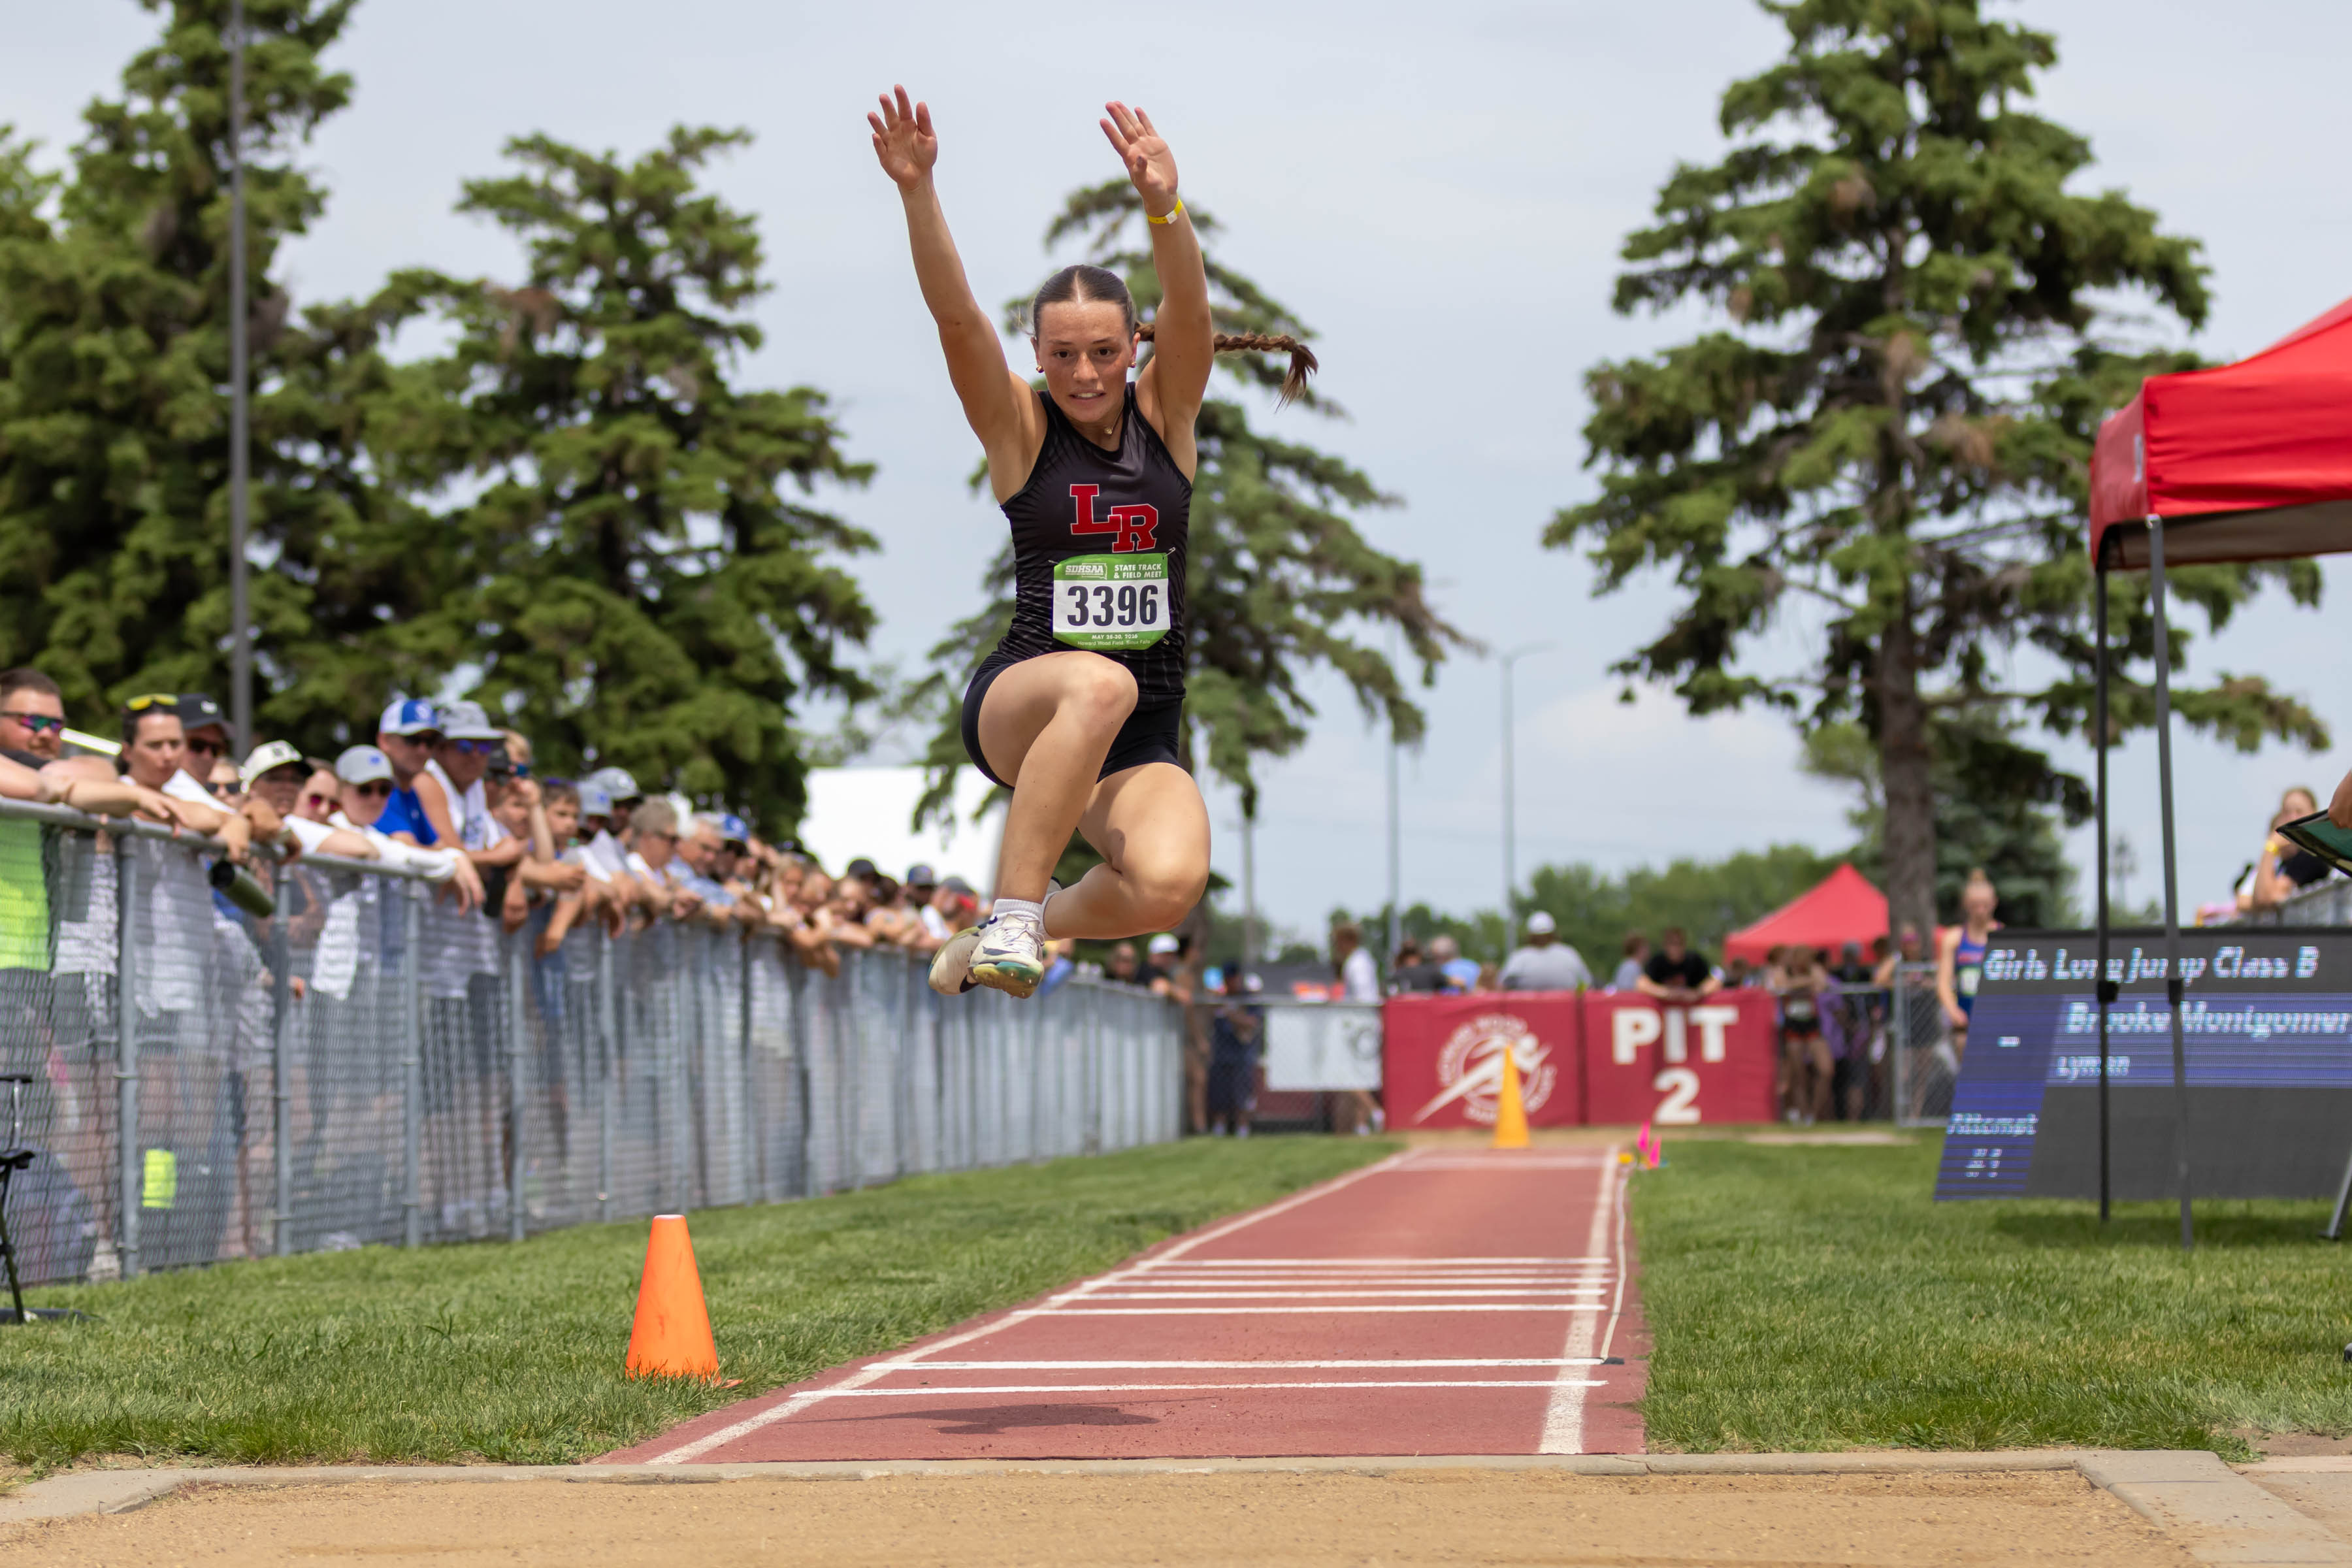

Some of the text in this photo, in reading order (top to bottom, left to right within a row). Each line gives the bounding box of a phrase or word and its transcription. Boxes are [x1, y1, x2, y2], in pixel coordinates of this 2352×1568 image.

[1070, 483, 1158, 553] LR
[1067, 585, 1158, 626] 3396
[1984, 949, 2048, 980] Girls
[2212, 946, 2289, 978] Class
[2295, 946, 2319, 978] B
[1612, 1005, 1739, 1064] PIT
[1654, 1066, 1701, 1124] 2
[1946, 1113, 2038, 1137] Attempt
